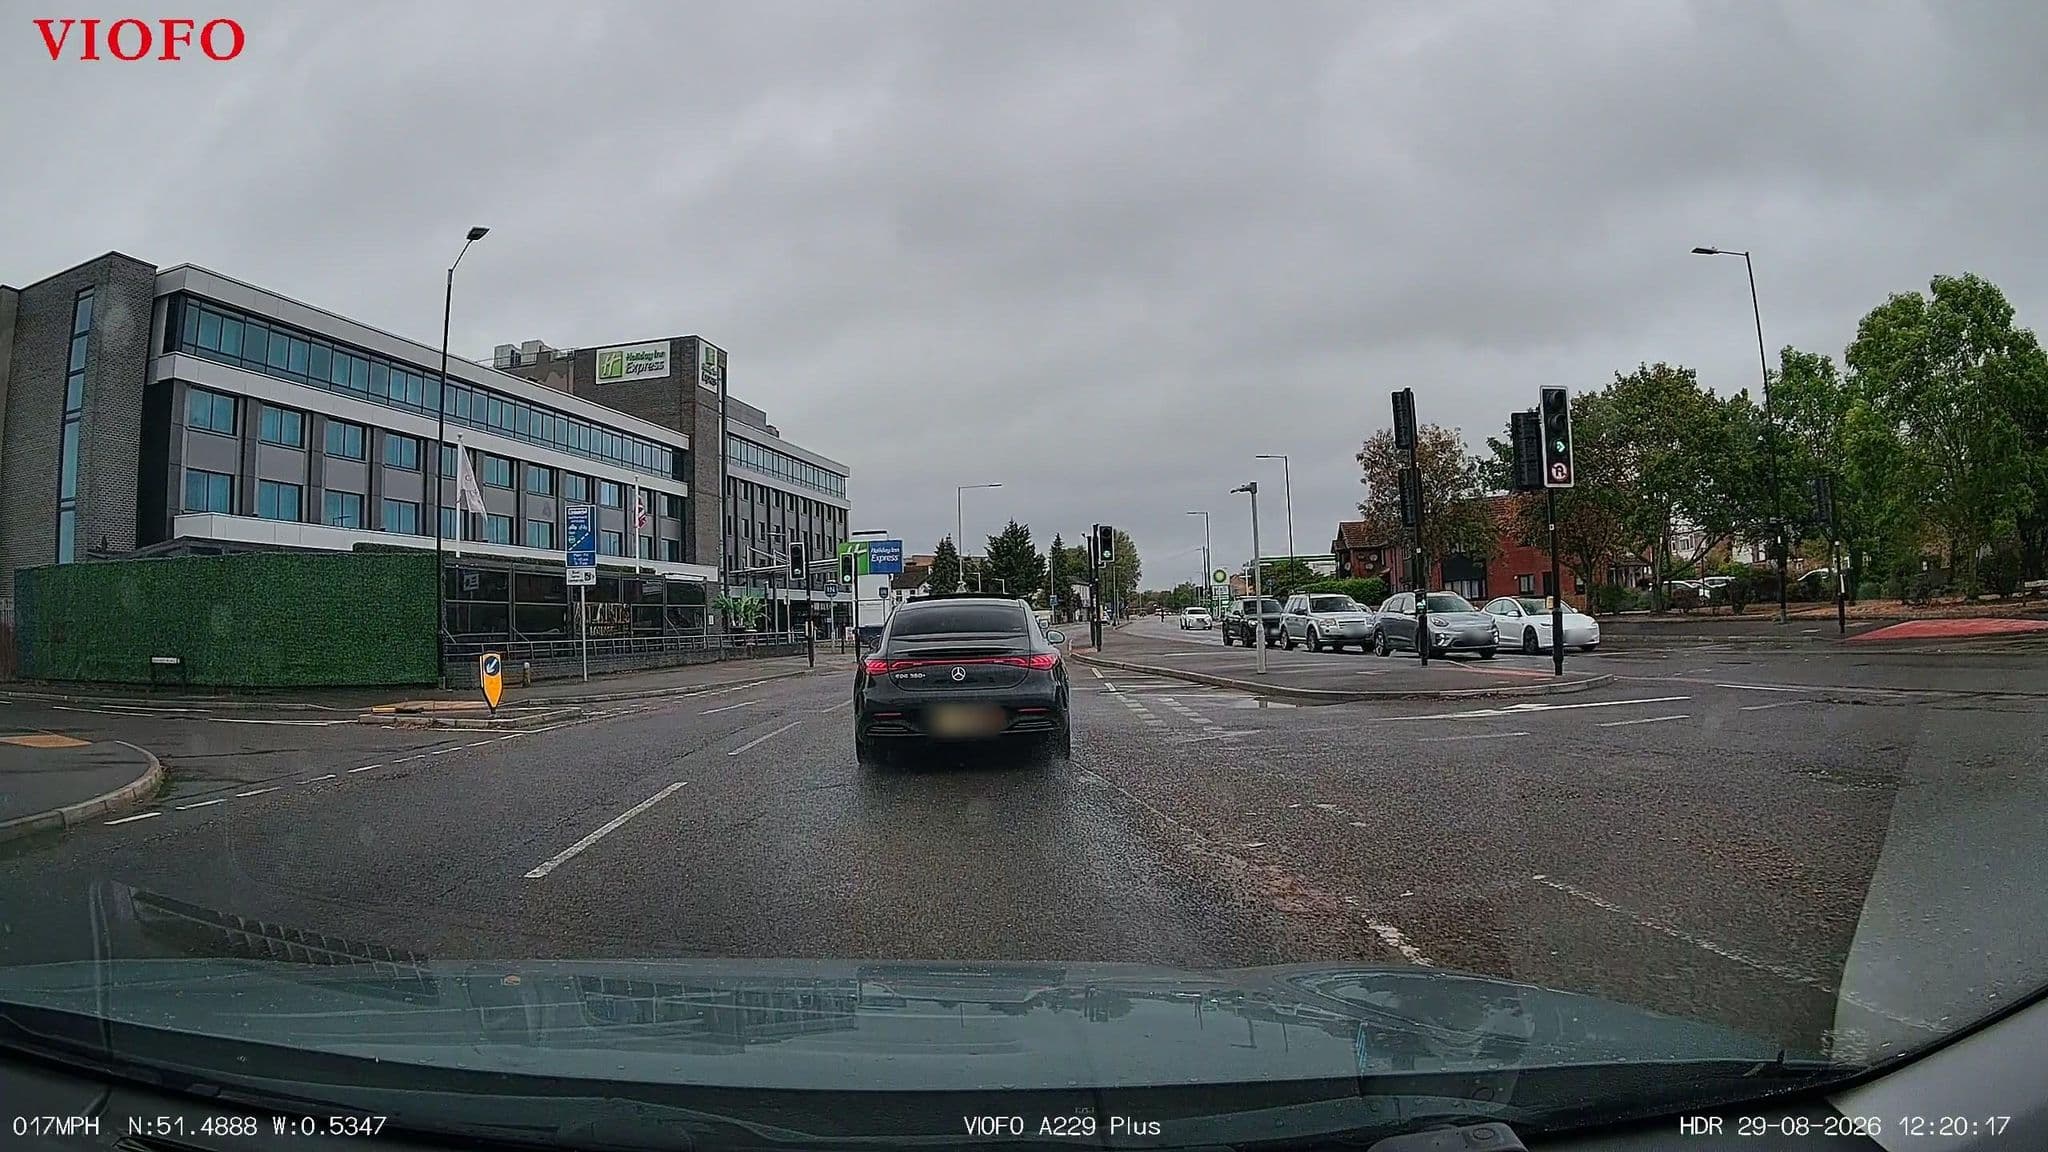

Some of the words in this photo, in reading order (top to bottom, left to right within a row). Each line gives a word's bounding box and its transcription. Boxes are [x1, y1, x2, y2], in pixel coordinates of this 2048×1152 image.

[626, 351, 654, 362] Holiday
[654, 350, 666, 358] Inn
[626, 361, 665, 375] Express
[871, 554, 899, 563] Express
